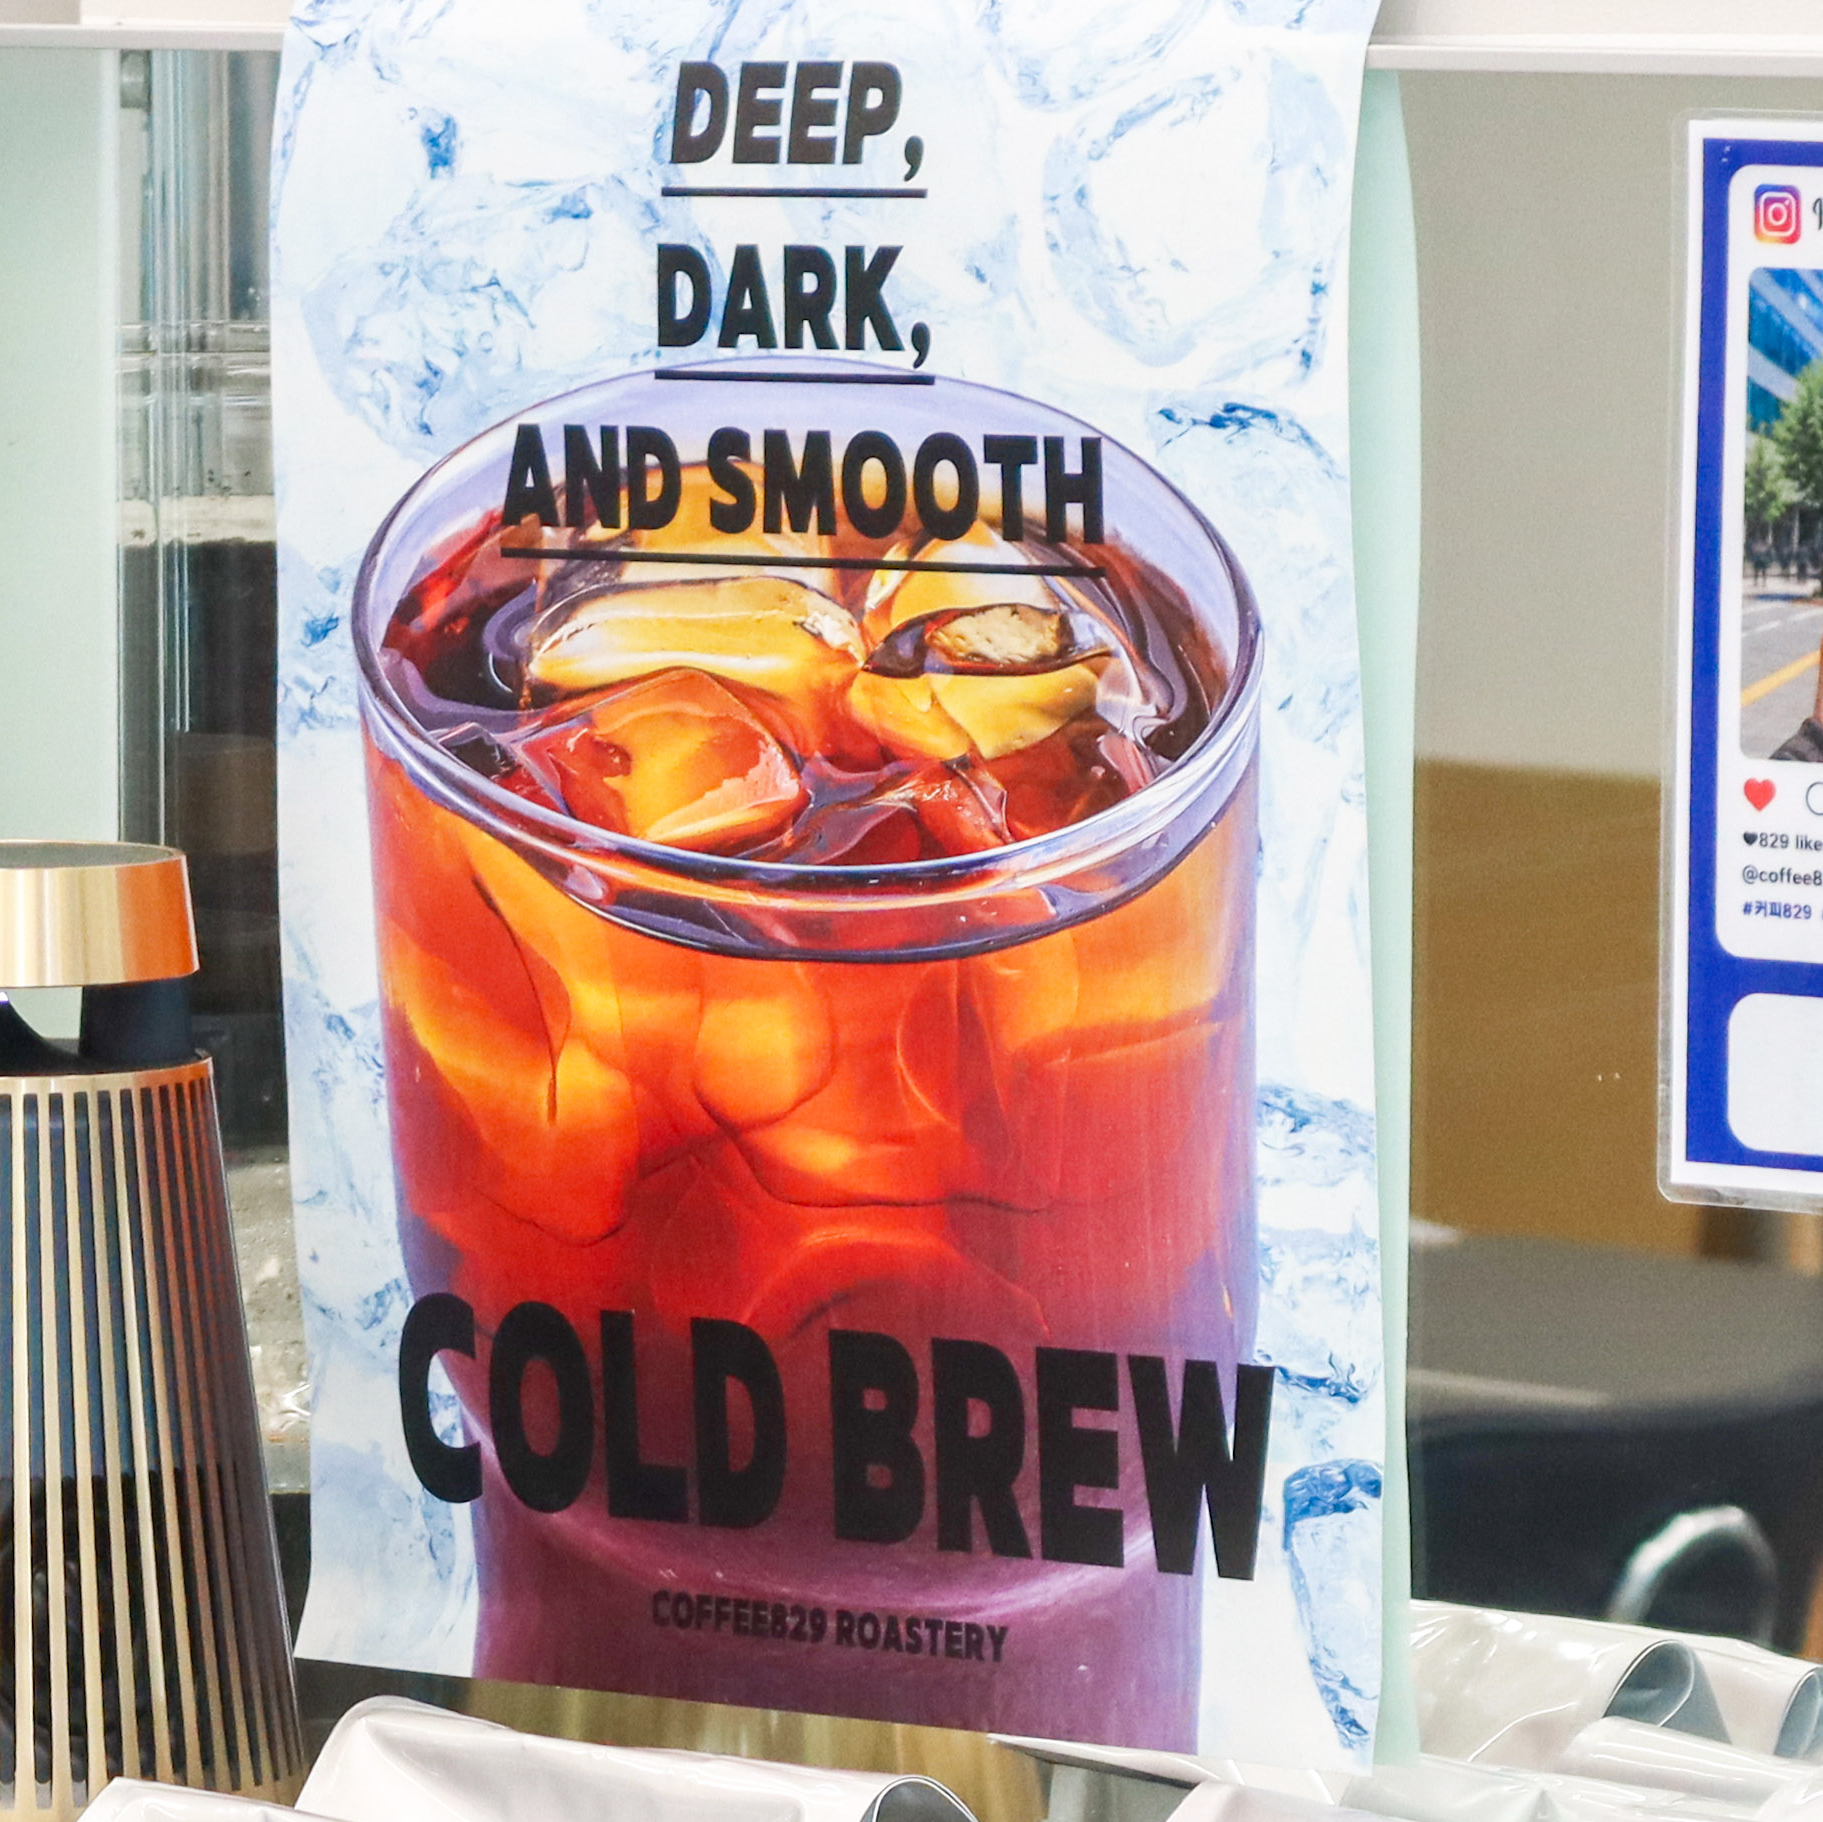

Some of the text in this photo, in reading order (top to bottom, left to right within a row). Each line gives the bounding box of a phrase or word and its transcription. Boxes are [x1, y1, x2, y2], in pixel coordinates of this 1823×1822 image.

[670, 60, 925, 181] DEEP,
[656, 243, 930, 366] DARK,
[502, 423, 1104, 543] AND SMOOTH
[1759, 832, 1789, 849] 829
[1743, 901, 1812, 919] #커피829
[399, 1293, 1275, 1581] COLD BREW
[835, 1608, 1008, 1663] ROASTERY
